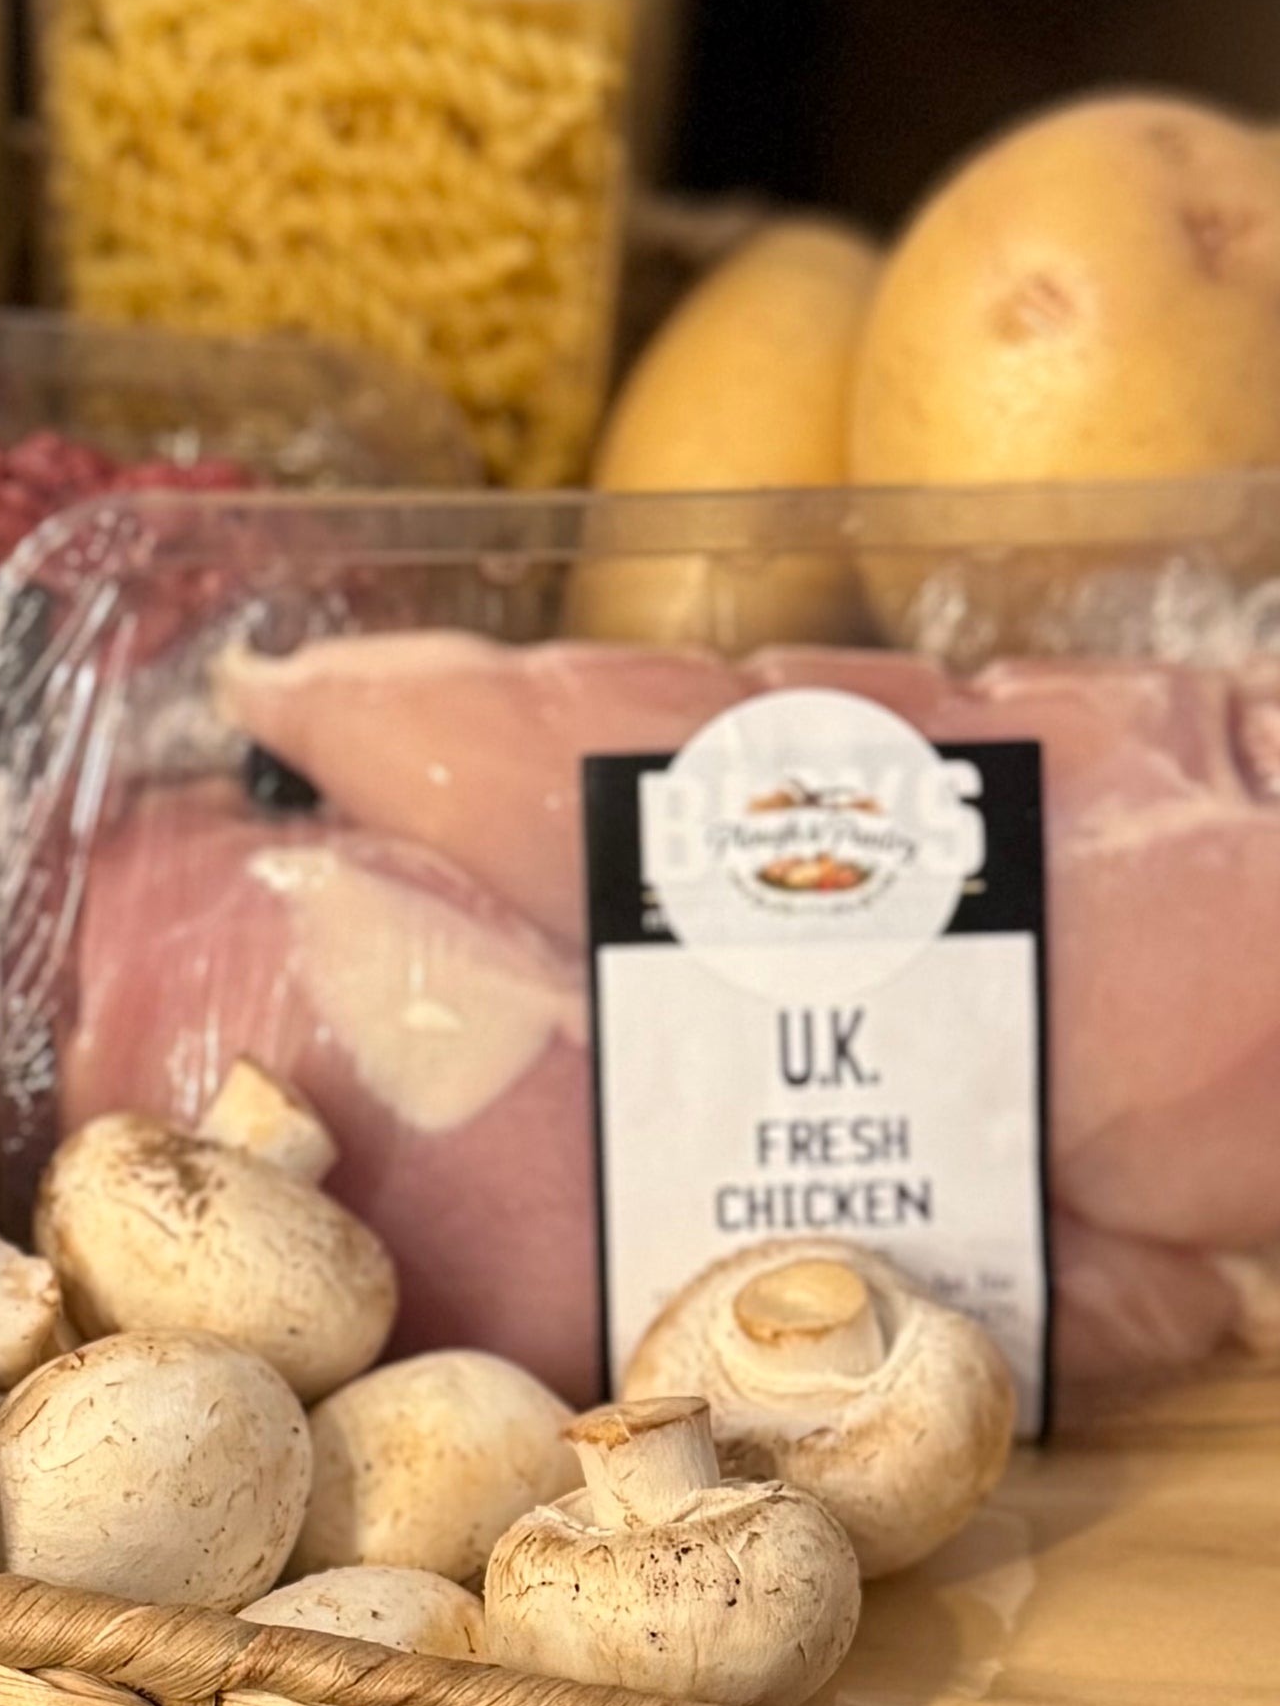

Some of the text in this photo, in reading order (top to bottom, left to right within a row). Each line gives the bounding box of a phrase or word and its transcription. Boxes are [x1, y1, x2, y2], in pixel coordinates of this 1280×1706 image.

[777, 1008, 880, 1088] U.K.
[756, 1118, 910, 1168] FRESH
[713, 1182, 933, 1233] CHICKEN
